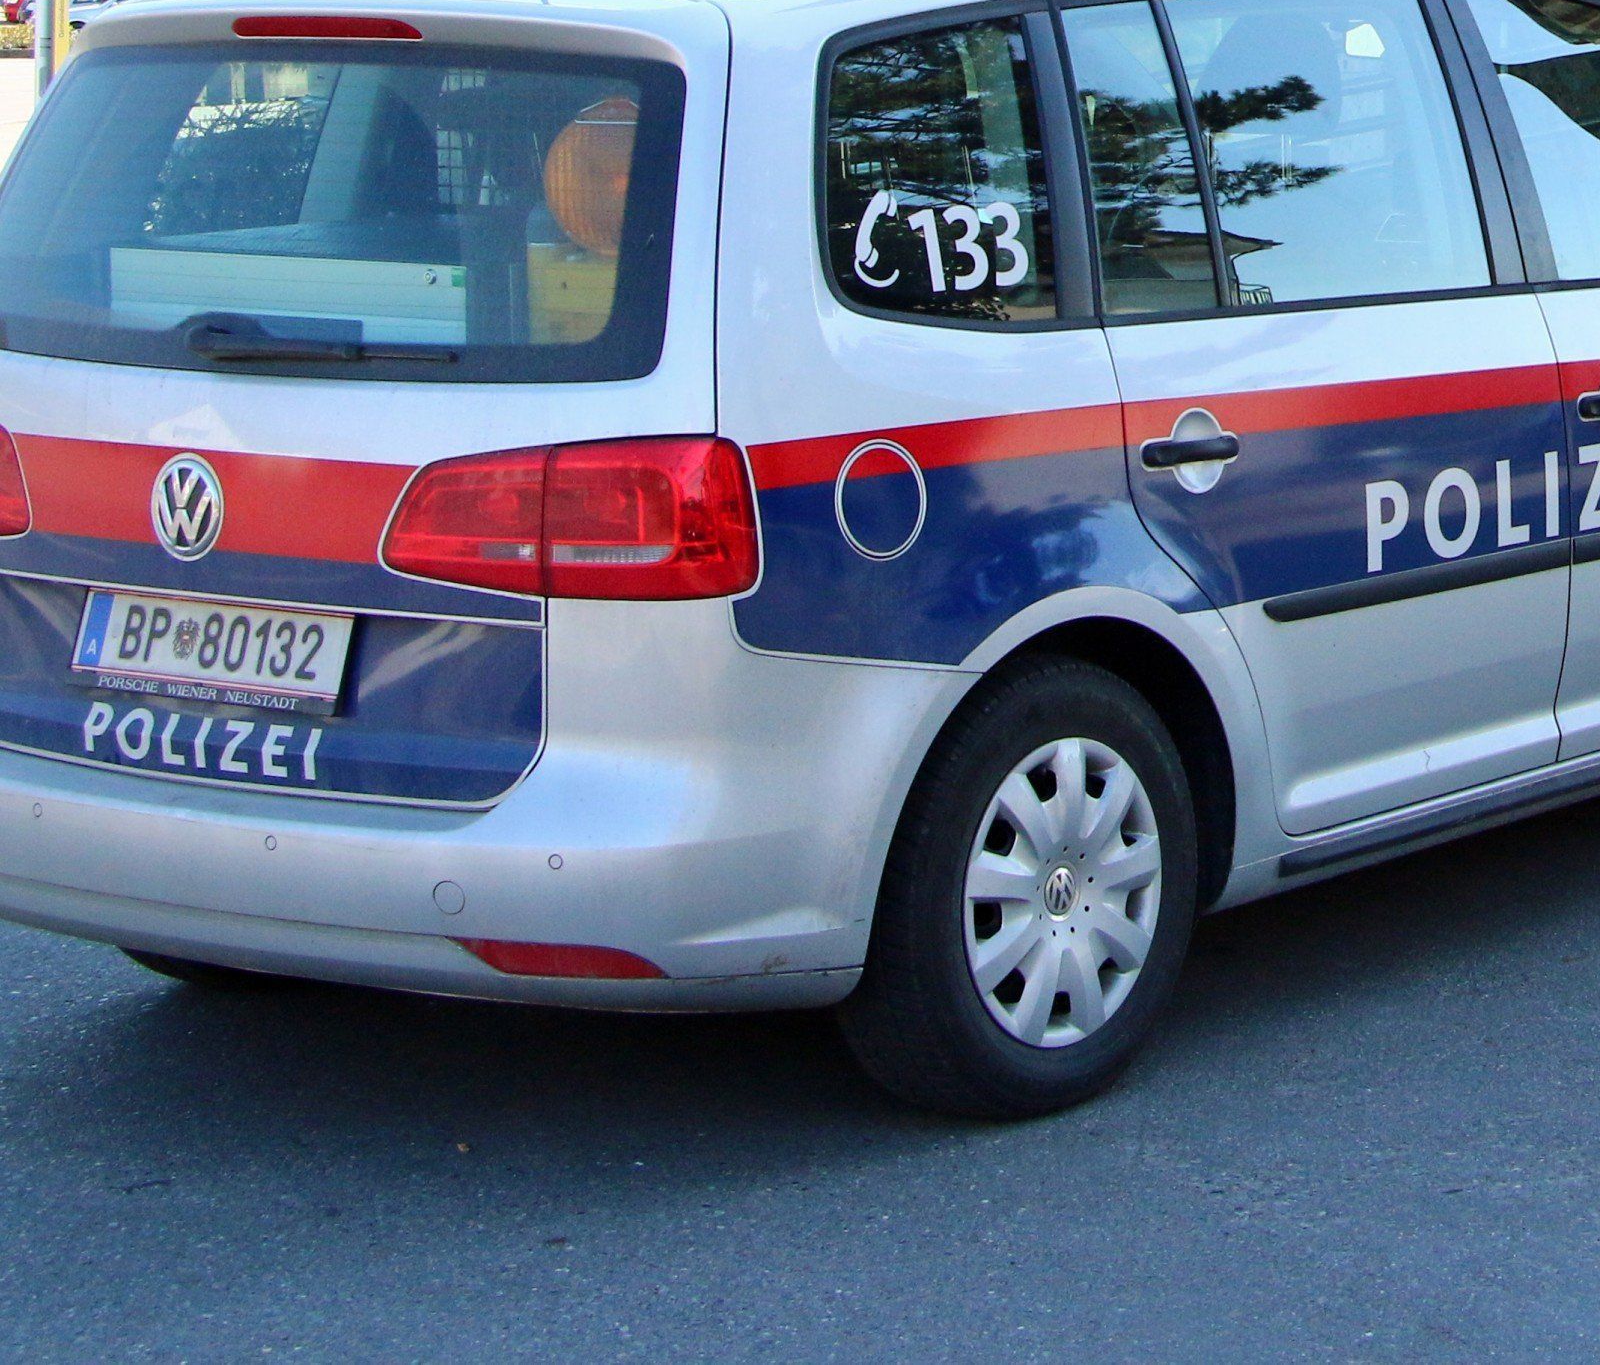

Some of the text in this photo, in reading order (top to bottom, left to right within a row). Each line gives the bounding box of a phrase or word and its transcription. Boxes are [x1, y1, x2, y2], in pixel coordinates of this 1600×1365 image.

[908, 201, 1029, 293] 133
[86, 638, 97, 656] A
[118, 604, 324, 680] BP 80132
[97, 675, 299, 710] PORSCHE WIENER NEUSTADT
[84, 701, 322, 780] POLIZEI
